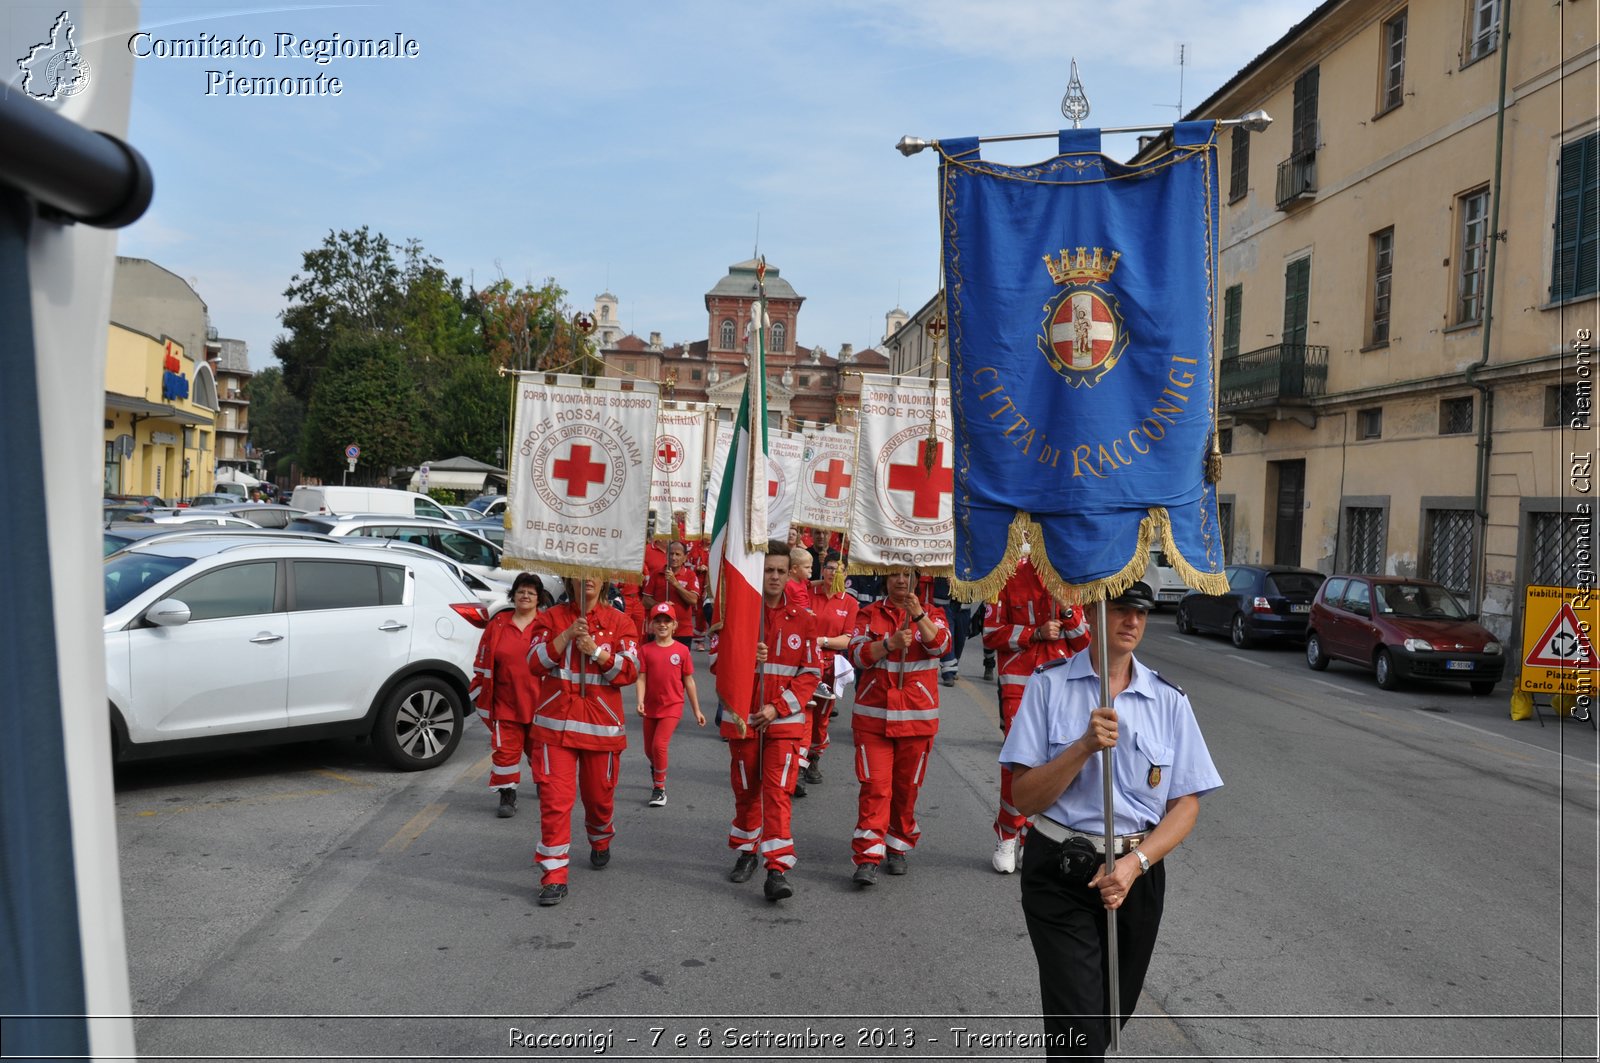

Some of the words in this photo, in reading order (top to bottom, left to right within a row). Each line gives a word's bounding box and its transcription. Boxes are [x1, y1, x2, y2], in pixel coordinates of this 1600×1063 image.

[523, 390, 548, 401] CORPO
[551, 393, 591, 405] VOLONTARI
[593, 397, 607, 407] DEL
[609, 398, 652, 409] SOCCORSO
[869, 391, 894, 402] CORPO
[940, 397, 951, 406] DE
[862, 404, 904, 417] CROCE
[907, 408, 948, 420] ROSSA
[1038, 444, 1061, 468] DI
[1071, 355, 1198, 478] RACCONIGI
[520, 417, 553, 457] CROCE
[555, 408, 600, 423] ROSSA
[604, 416, 642, 467] ITALIANA
[549, 436, 559, 446] DI
[560, 426, 603, 441] GINEVRA
[604, 439, 618, 453] 22
[879, 425, 934, 464] CONVENZION
[533, 444, 564, 511] CONVENZIONE
[608, 455, 625, 497] AGOSTO
[588, 499, 611, 514] 1864
[808, 512, 845, 523] MORETT
[526, 520, 607, 538] DELEGAZIONE
[610, 528, 623, 539] DI
[545, 538, 600, 554] BARGE
[863, 533, 919, 548] COMITATO
[923, 539, 953, 549] LOCA
[1546, 670, 1578, 679] Piazza
[1525, 680, 1553, 690] Carlo
